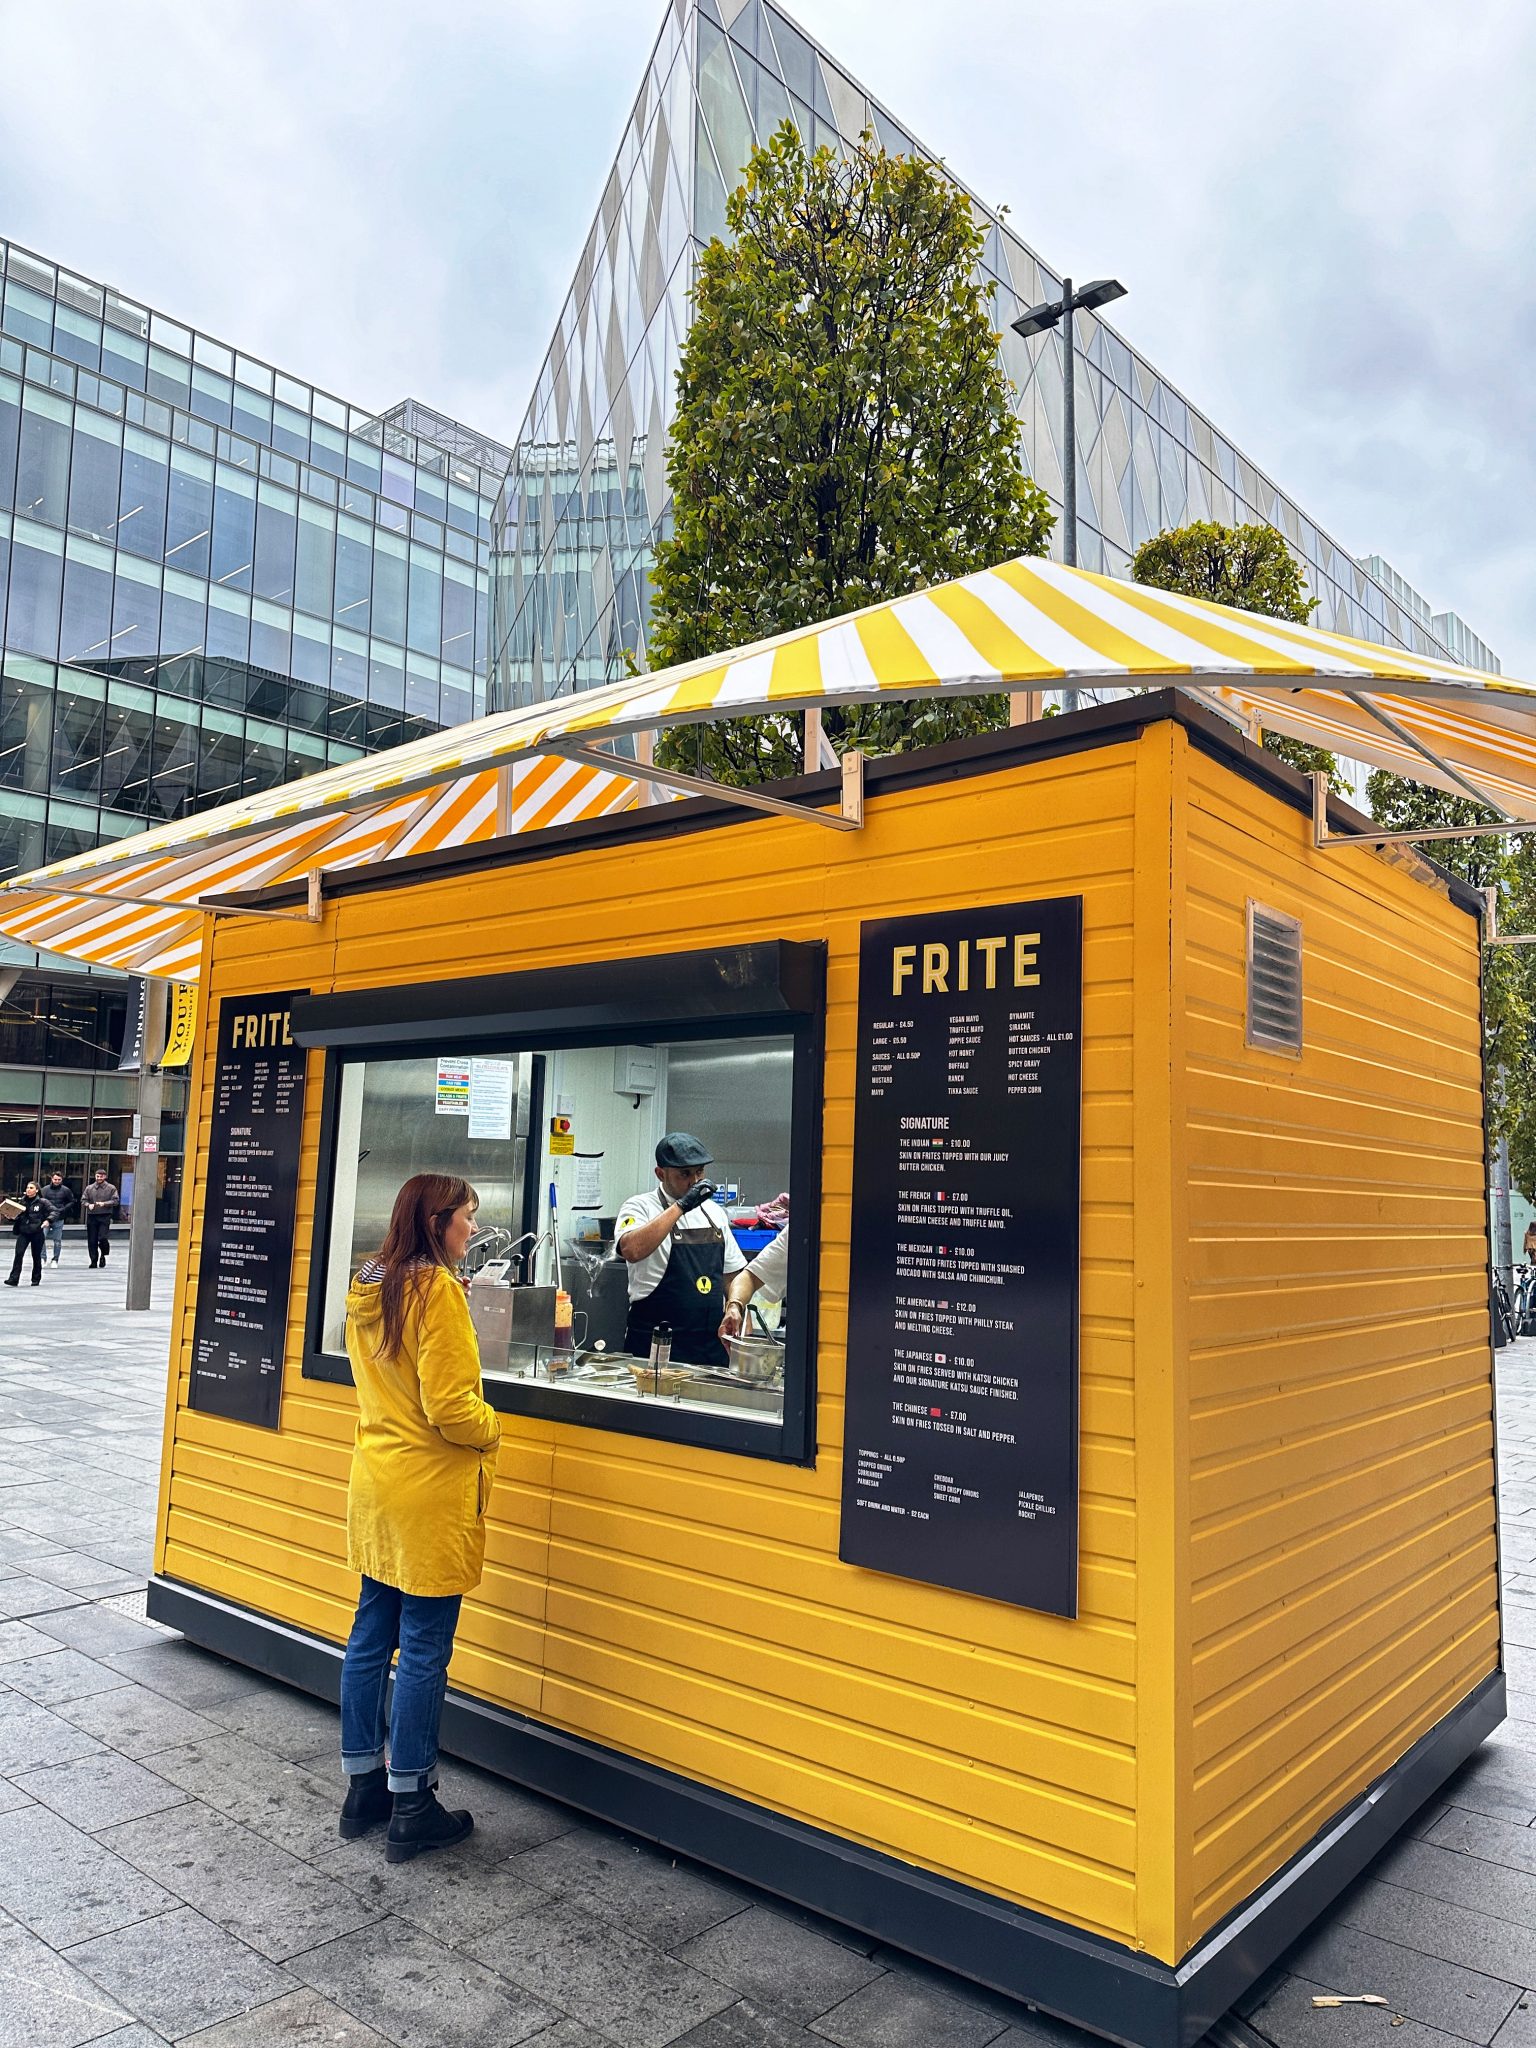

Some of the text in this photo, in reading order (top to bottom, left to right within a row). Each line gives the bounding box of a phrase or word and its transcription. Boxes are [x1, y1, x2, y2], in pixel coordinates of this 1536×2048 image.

[892, 933, 1040, 996] FRITE
[1010, 1012, 1035, 1020] DYNAMITE
[232, 1012, 293, 1048] FRITE
[900, 1117, 949, 1129] SIGNATURE
[942, 1152, 963, 1160] TOPPED
[980, 1153, 992, 1161] OUR
[993, 1153, 1009, 1161] JUICY
[899, 1163, 945, 1171] BUTTER CHICKEN.
[910, 1191, 931, 1200] FRENCH
[952, 1193, 968, 1201] £7.00
[921, 1205, 936, 1213] FRIES
[938, 1205, 959, 1214] TOPPED
[976, 1207, 1000, 1216] TRUFFLE
[1002, 1209, 1013, 1217] OIL,
[898, 1215, 1005, 1228] PARMESAN CHEESE AND TRUFFLE MAYO.
[897, 1244, 975, 1256] THE MEXICAN £10.00
[897, 1256, 915, 1265] SWEET
[916, 1258, 936, 1267] POTATO
[958, 1261, 980, 1270] TOPPED
[981, 1263, 996, 1272] WITH
[997, 1264, 1025, 1274] SMASHED
[896, 1268, 921, 1277] AVOCADO
[922, 1270, 936, 1278] WITH
[937, 1271, 955, 1280] SALSA
[956, 1273, 968, 1281] AND
[896, 1296, 976, 1312] THE AMERICAN £12.00
[895, 1310, 1014, 1330] SKIN ON FRIES TOPPED WITH PHILLY STEAK
[894, 1321, 954, 1335] AND MELTING CHEESE.
[894, 1349, 974, 1367] THE JAPANESE £10.00
[894, 1362, 1018, 1387] SKIN ON FRIES SERVED WITH KATSU CHICKEN
[893, 1374, 1018, 1400] AND OUR SIGNATURE KATSU SAUCE FINISHED.
[892, 1402, 967, 1421] THE CHINESE £7.00
[892, 1415, 1016, 1444] SKIN ON FRIES TOSSED IN SALT AND PEPPER.
[858, 1460, 876, 1469] CHOPPED
[934, 1483, 946, 1492] FRIED
[934, 1492, 948, 1501] SWEET
[1018, 1500, 1056, 1514] PICKLE CHILLIES
[1018, 1510, 1036, 1519] ROCKET
